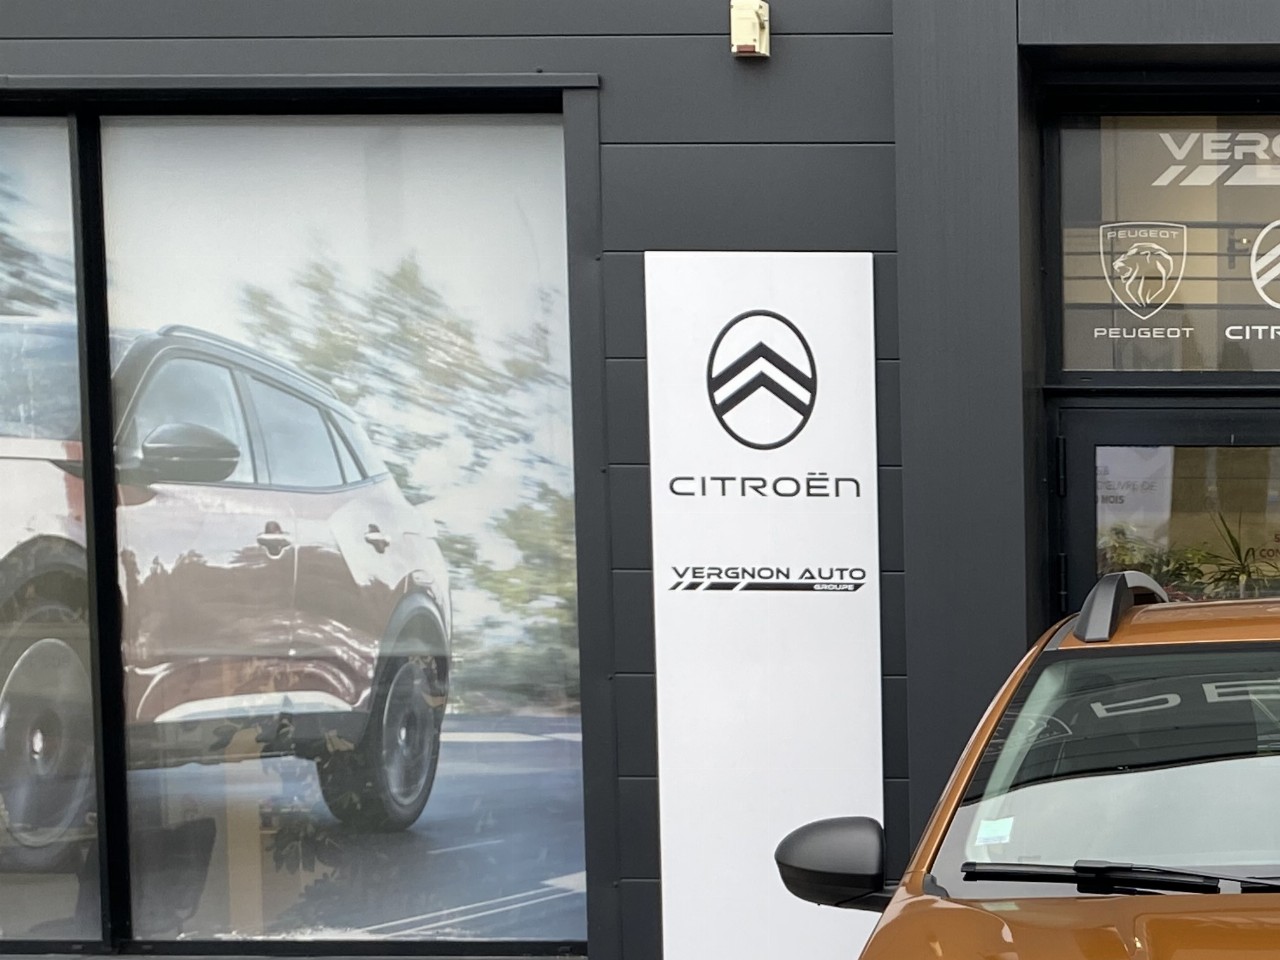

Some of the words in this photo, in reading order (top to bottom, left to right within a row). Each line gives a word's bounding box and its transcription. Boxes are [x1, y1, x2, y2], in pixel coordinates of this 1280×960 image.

[1106, 228, 1180, 241] PEUGEOT
[1094, 327, 1194, 339] PEUGEOT
[669, 472, 861, 498] CITROËN
[671, 566, 790, 580] VERGNON
[798, 567, 867, 581] AUTO
[813, 583, 855, 591] GROUPE
